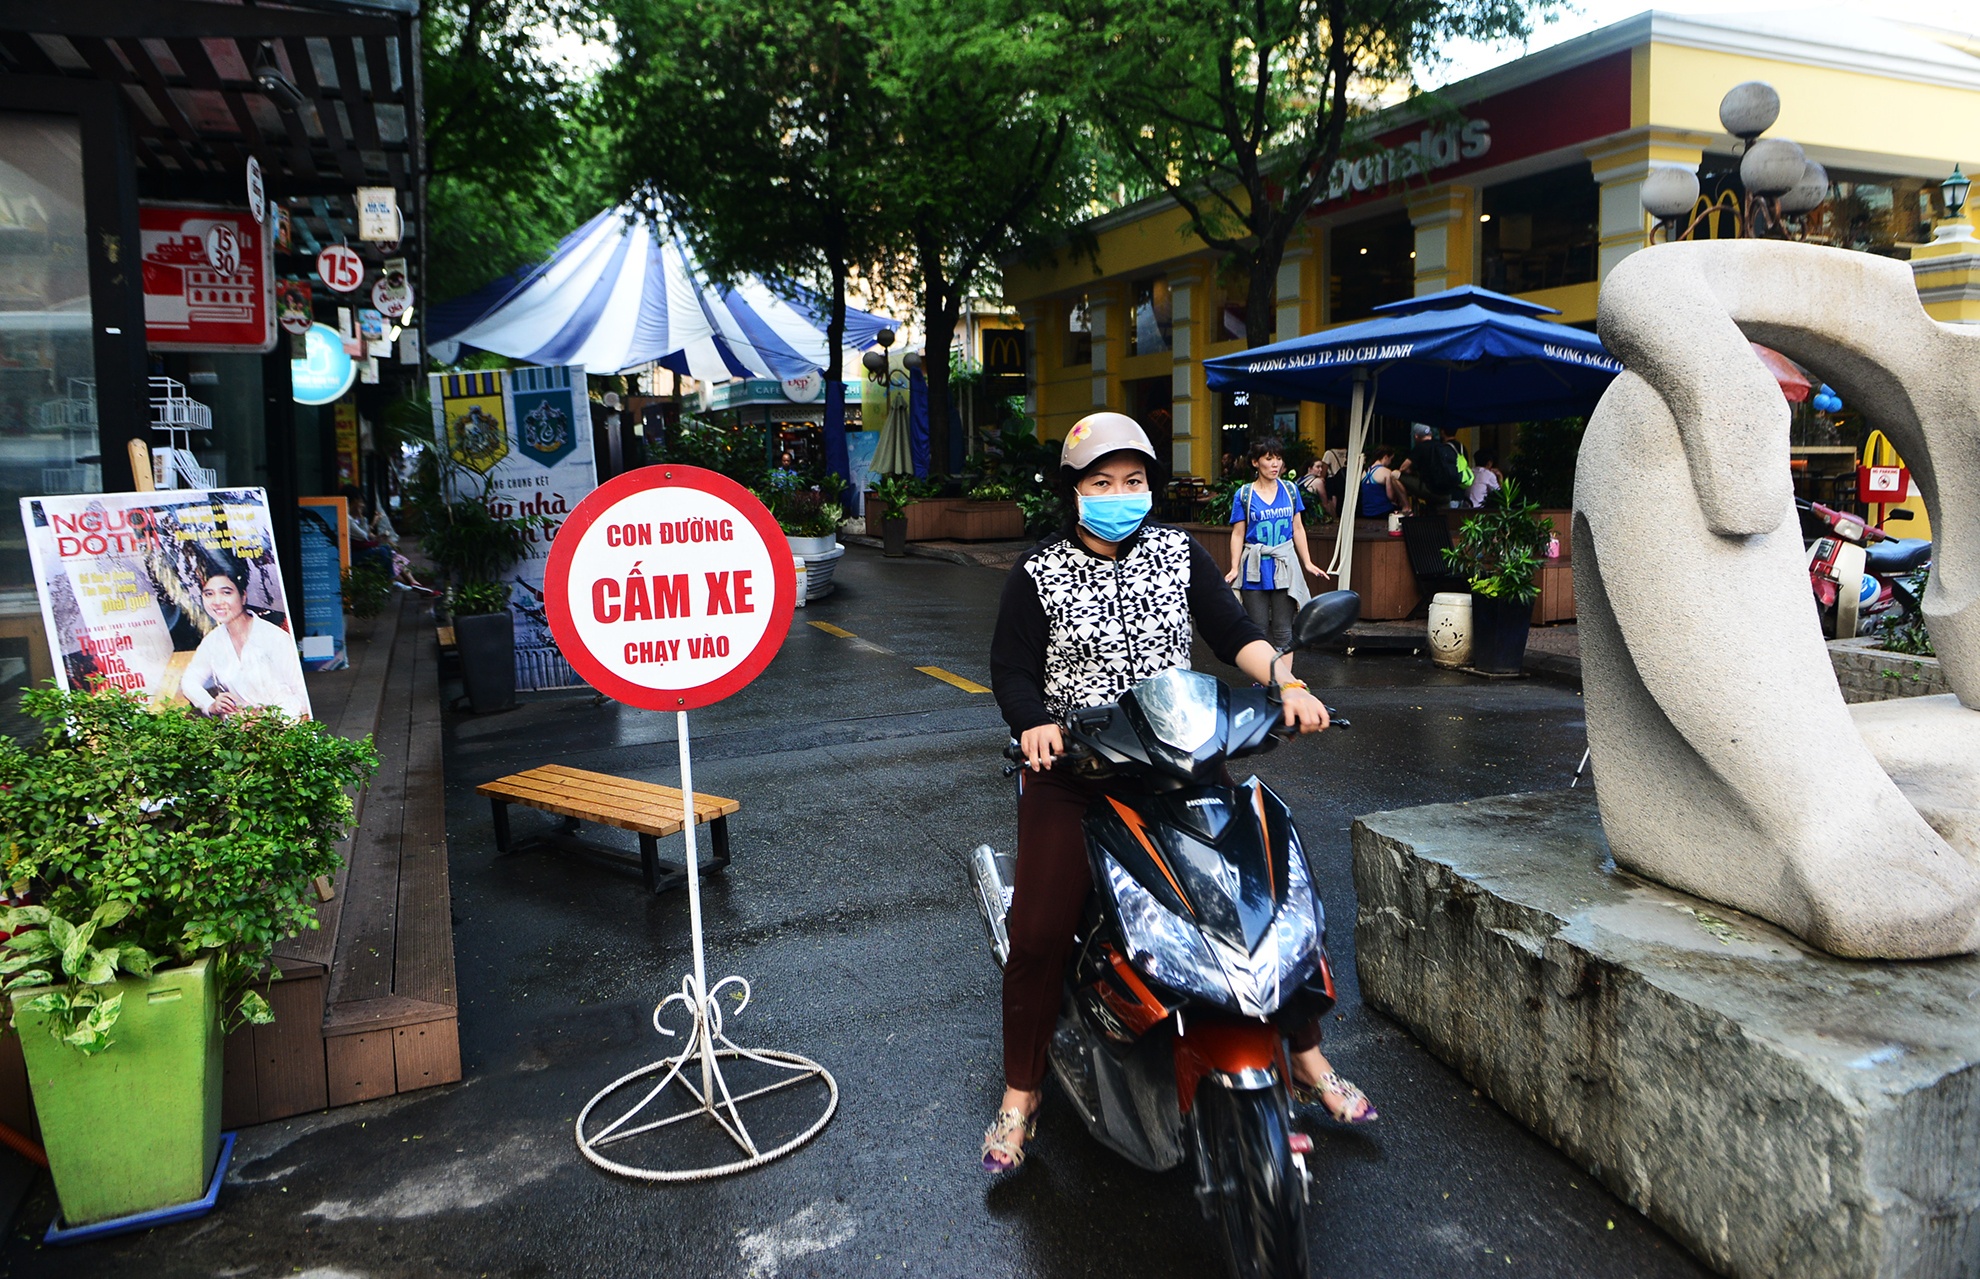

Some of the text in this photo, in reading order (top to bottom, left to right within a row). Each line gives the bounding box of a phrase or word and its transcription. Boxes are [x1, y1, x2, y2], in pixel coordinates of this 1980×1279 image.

[215, 248, 234, 275] 30
[321, 253, 358, 287] 15
[1378, 344, 1414, 360] MINH
[507, 477, 532, 489] CHUNG
[519, 492, 571, 517] nhà
[606, 517, 733, 547] CON ĐƯỜNG
[591, 560, 755, 624] CẤM XE
[77, 631, 133, 656] Thuyền
[624, 633, 730, 666] CHẠY VÀO
[1185, 797, 1225, 807] HONDA
